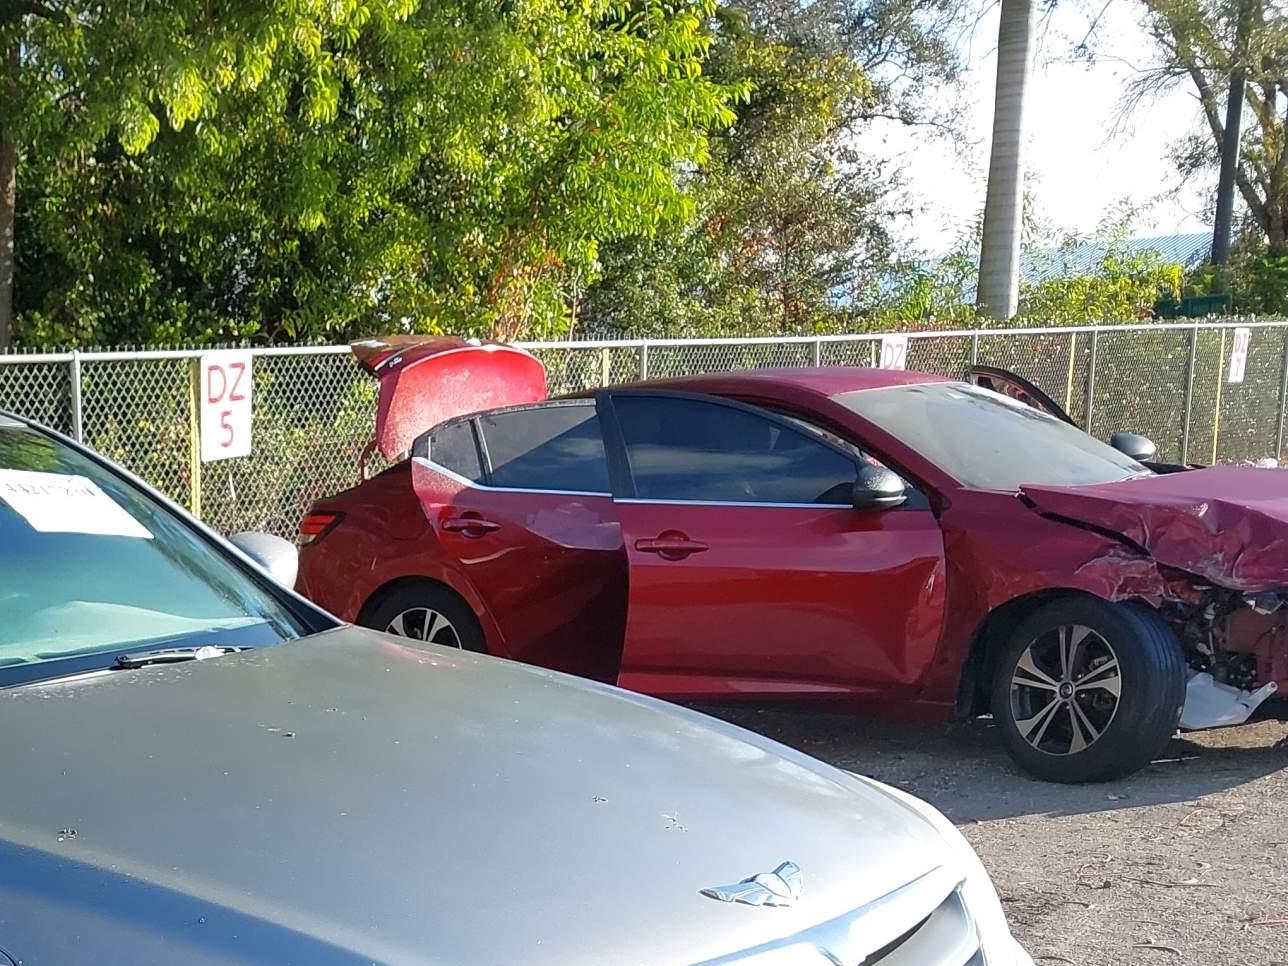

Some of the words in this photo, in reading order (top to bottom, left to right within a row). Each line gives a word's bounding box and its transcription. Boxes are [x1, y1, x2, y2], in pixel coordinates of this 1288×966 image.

[883, 343, 905, 369] DZ
[207, 362, 246, 404] DZ
[220, 410, 234, 448] 5
